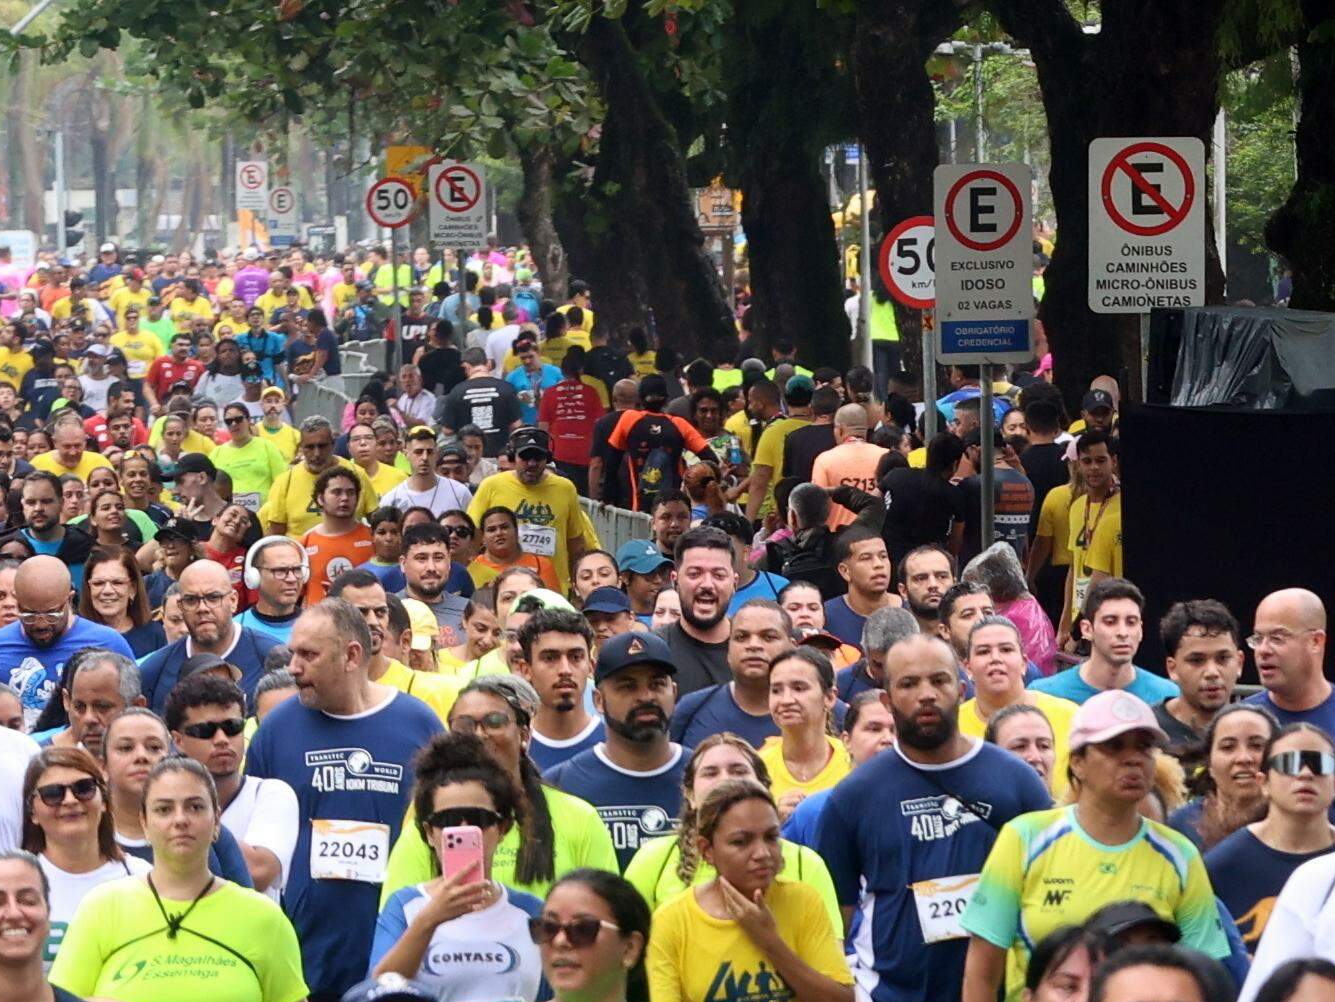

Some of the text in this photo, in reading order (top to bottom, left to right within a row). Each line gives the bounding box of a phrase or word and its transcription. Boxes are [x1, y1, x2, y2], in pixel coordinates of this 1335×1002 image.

[376, 188, 408, 210] 50
[969, 187, 997, 233] E
[1120, 243, 1172, 257] ÔNIBUS
[950, 260, 1015, 272] EXCLUSIVO
[1106, 260, 1187, 274] CAMINHÕES
[961, 278, 1006, 291] IDOSO
[1096, 276, 1197, 291] MICRO-ÔNIBUS
[957, 299, 1012, 312] 02 VAGAS
[1102, 295, 1191, 309] CAMIONETAS
[954, 325, 1016, 337] OBRIGATÓRIO
[521, 532, 551, 547] 27749
[311, 765, 334, 792] 40
[319, 842, 380, 862] 22043
[431, 950, 504, 968] CONTASC
